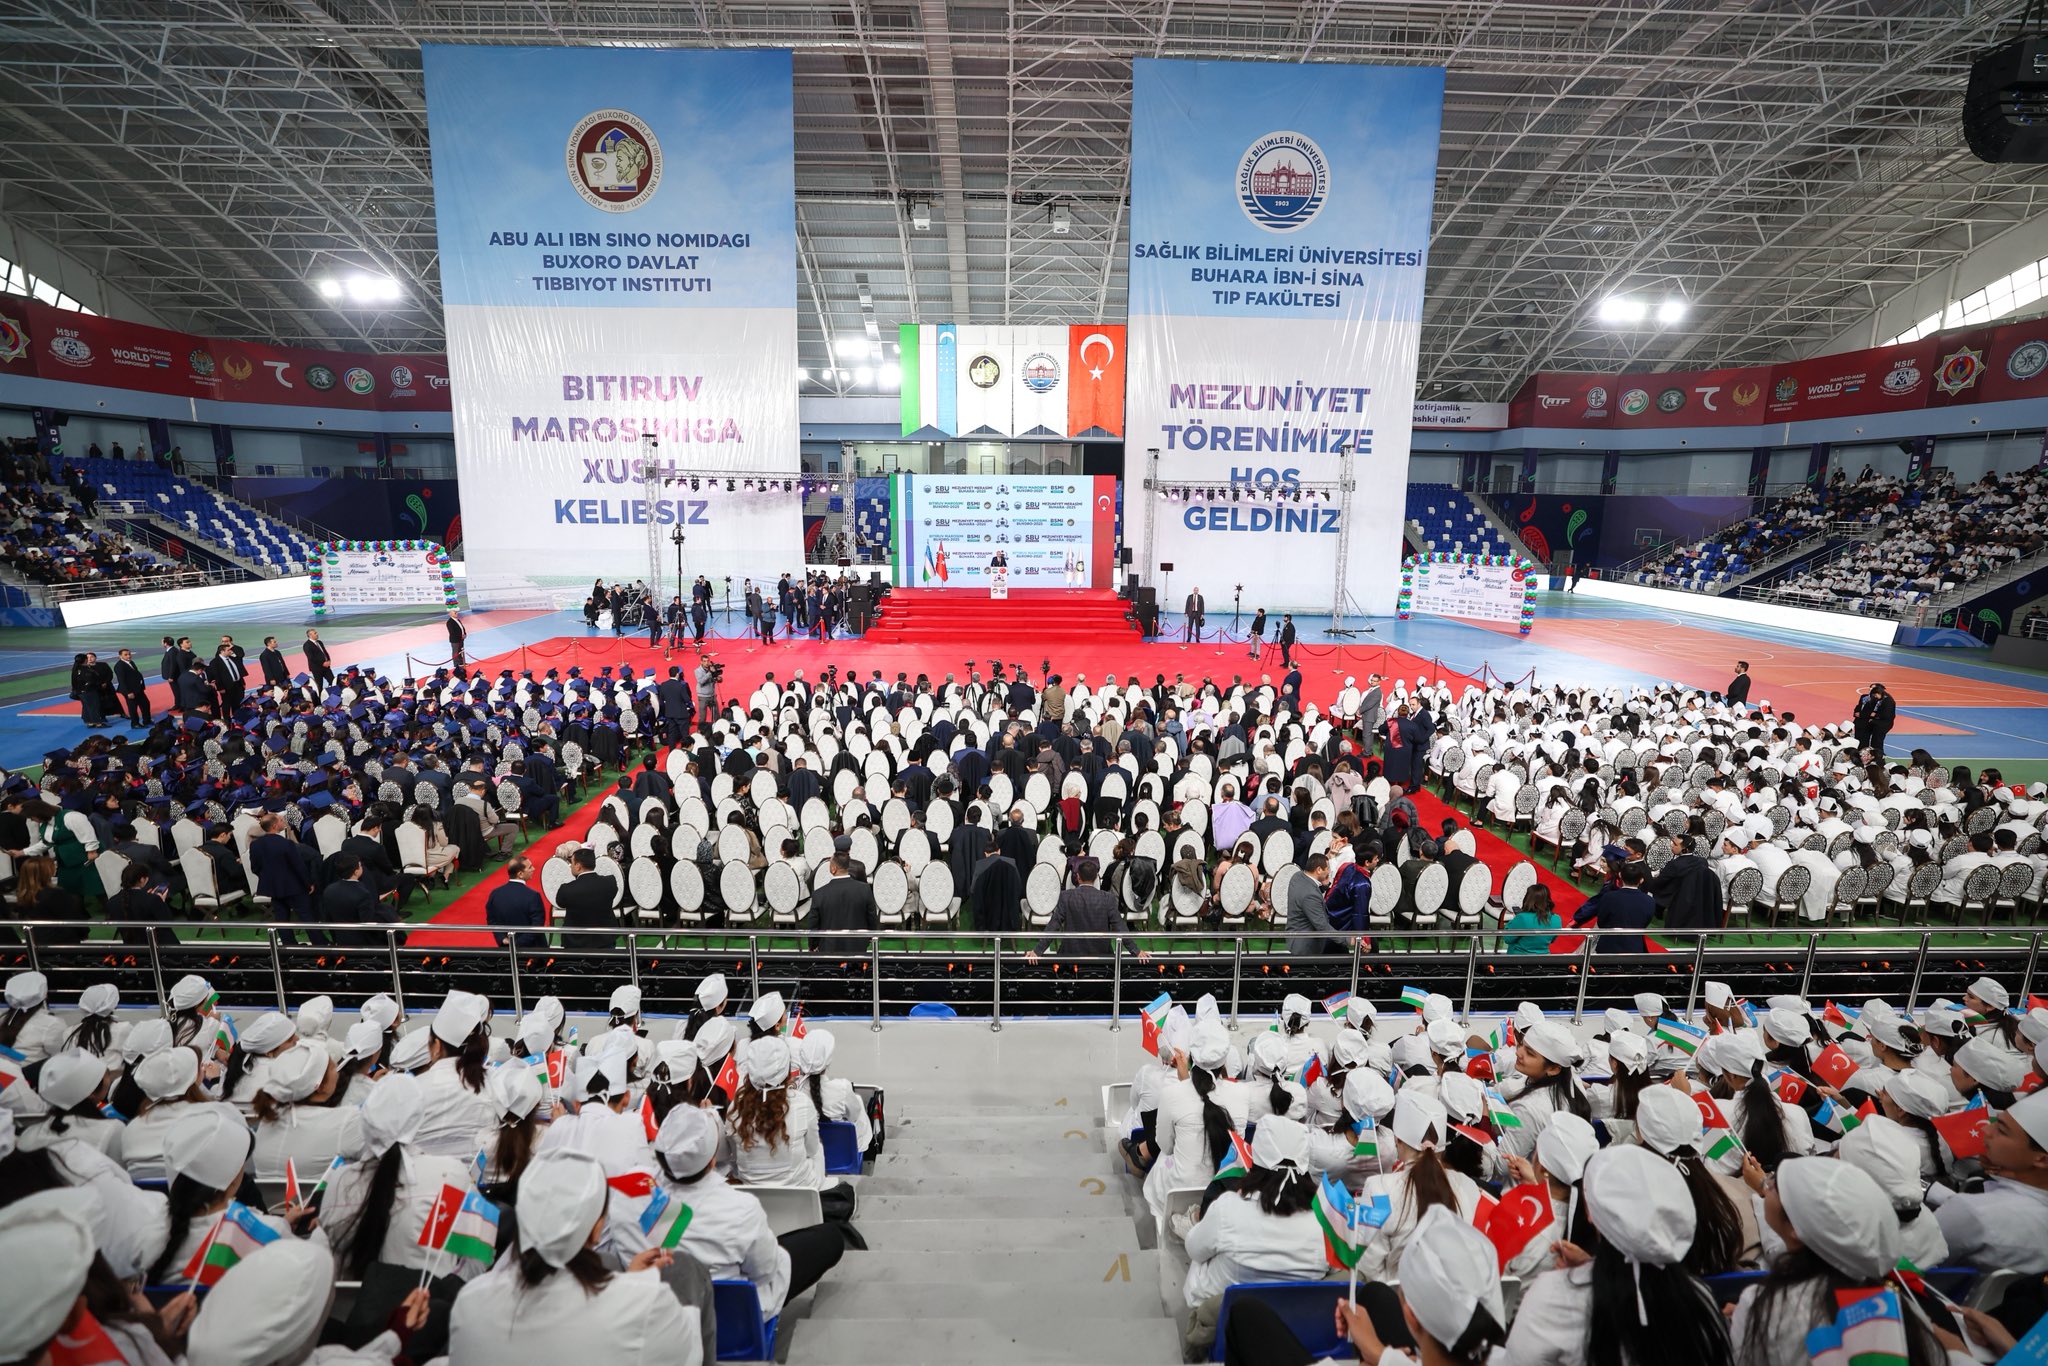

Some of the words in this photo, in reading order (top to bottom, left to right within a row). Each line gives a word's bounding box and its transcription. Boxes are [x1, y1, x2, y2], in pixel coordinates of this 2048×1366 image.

[597, 111, 629, 121] BUXORO
[571, 116, 597, 149] NOMIDAGI
[630, 118, 654, 141] DAVLAT
[651, 143, 661, 180] TIBBIYOT
[1240, 157, 1254, 192] SAĞLIK
[1252, 135, 1294, 157] BİLİMLERİ
[1295, 137, 1326, 194] ÜNİVERSİTESİ
[570, 170, 580, 184] IBN
[577, 184, 590, 197] ALI
[589, 194, 603, 207] ABU
[489, 231, 528, 247] ABU
[534, 231, 564, 247] ALI
[570, 232, 601, 247] IBN
[606, 232, 651, 247] SINO
[656, 232, 750, 248] NOMIDAGI
[543, 255, 622, 270] BUXORO
[628, 256, 699, 270] DAVLAT
[1134, 241, 1200, 260] SAĞLIK
[1206, 243, 1294, 263] BİLİMLERİ
[1299, 245, 1422, 267] ÜNİVERSİTESİ
[532, 276, 617, 291] TIBBIYOT
[622, 277, 712, 292] INSTITUTI
[1191, 268, 1268, 284] BUHARA
[1273, 266, 1317, 286] İBN-İ
[1321, 270, 1364, 287] SİNA
[1212, 290, 1241, 305] TIP
[1246, 289, 1341, 307] FAKÜLTESİ
[56, 327, 80, 338] HSIF
[111, 347, 150, 362] WORLD
[1894, 358, 1917, 369] HSIF
[562, 375, 704, 401] BITIRUV
[1169, 380, 1371, 414] MEZUNİYET
[1808, 383, 1842, 395] WORLD
[1413, 403, 1460, 412] xotirjamlik
[512, 415, 744, 443] MAROSIMIGA
[1161, 418, 1374, 454] TÖRENİMİZE
[582, 458, 676, 484] XUSH
[1231, 467, 1301, 497] HOŞ
[554, 499, 710, 525] KELIBSIZ
[1183, 502, 1341, 533] GELDİNİZ
